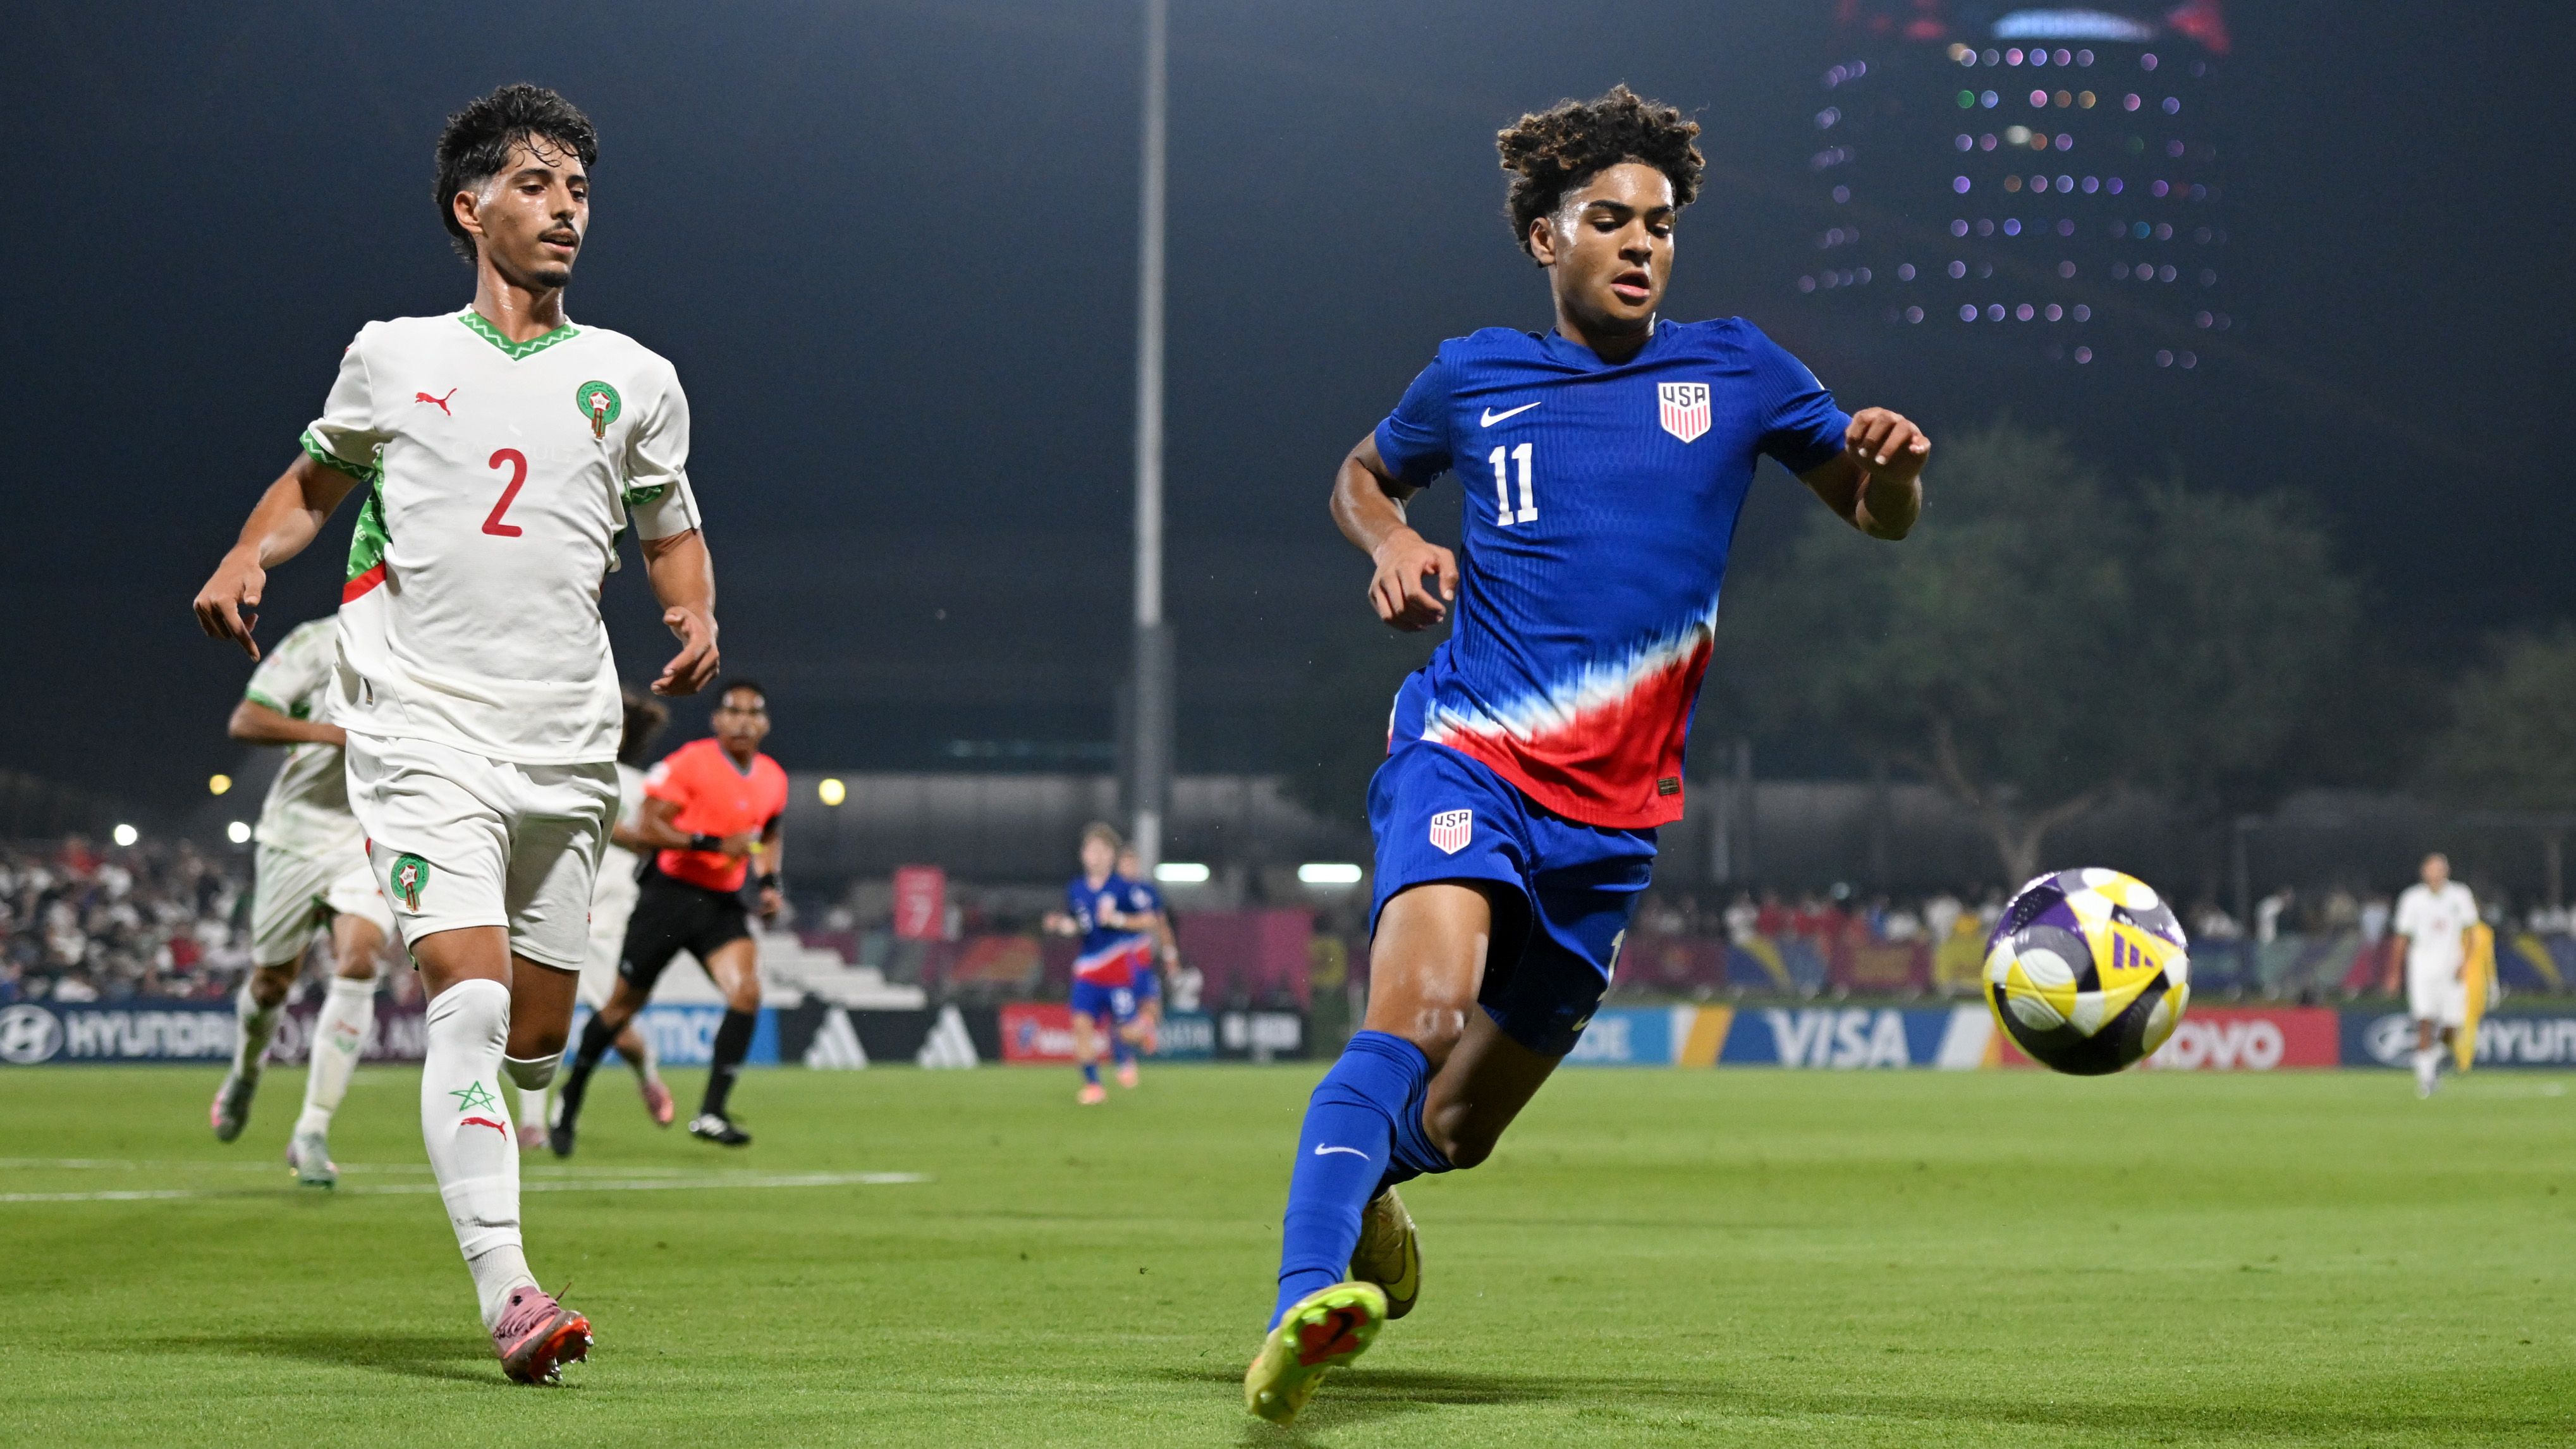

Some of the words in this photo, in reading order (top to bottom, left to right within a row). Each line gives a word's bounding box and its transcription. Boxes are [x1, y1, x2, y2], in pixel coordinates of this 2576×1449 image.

[1663, 386, 1706, 407] USA
[482, 448, 527, 537] 2
[1489, 443, 1538, 526] 11
[1434, 812, 1468, 828] USA
[1770, 1010, 1910, 1067] VISA
[2474, 1018, 2576, 1060] HYUN
